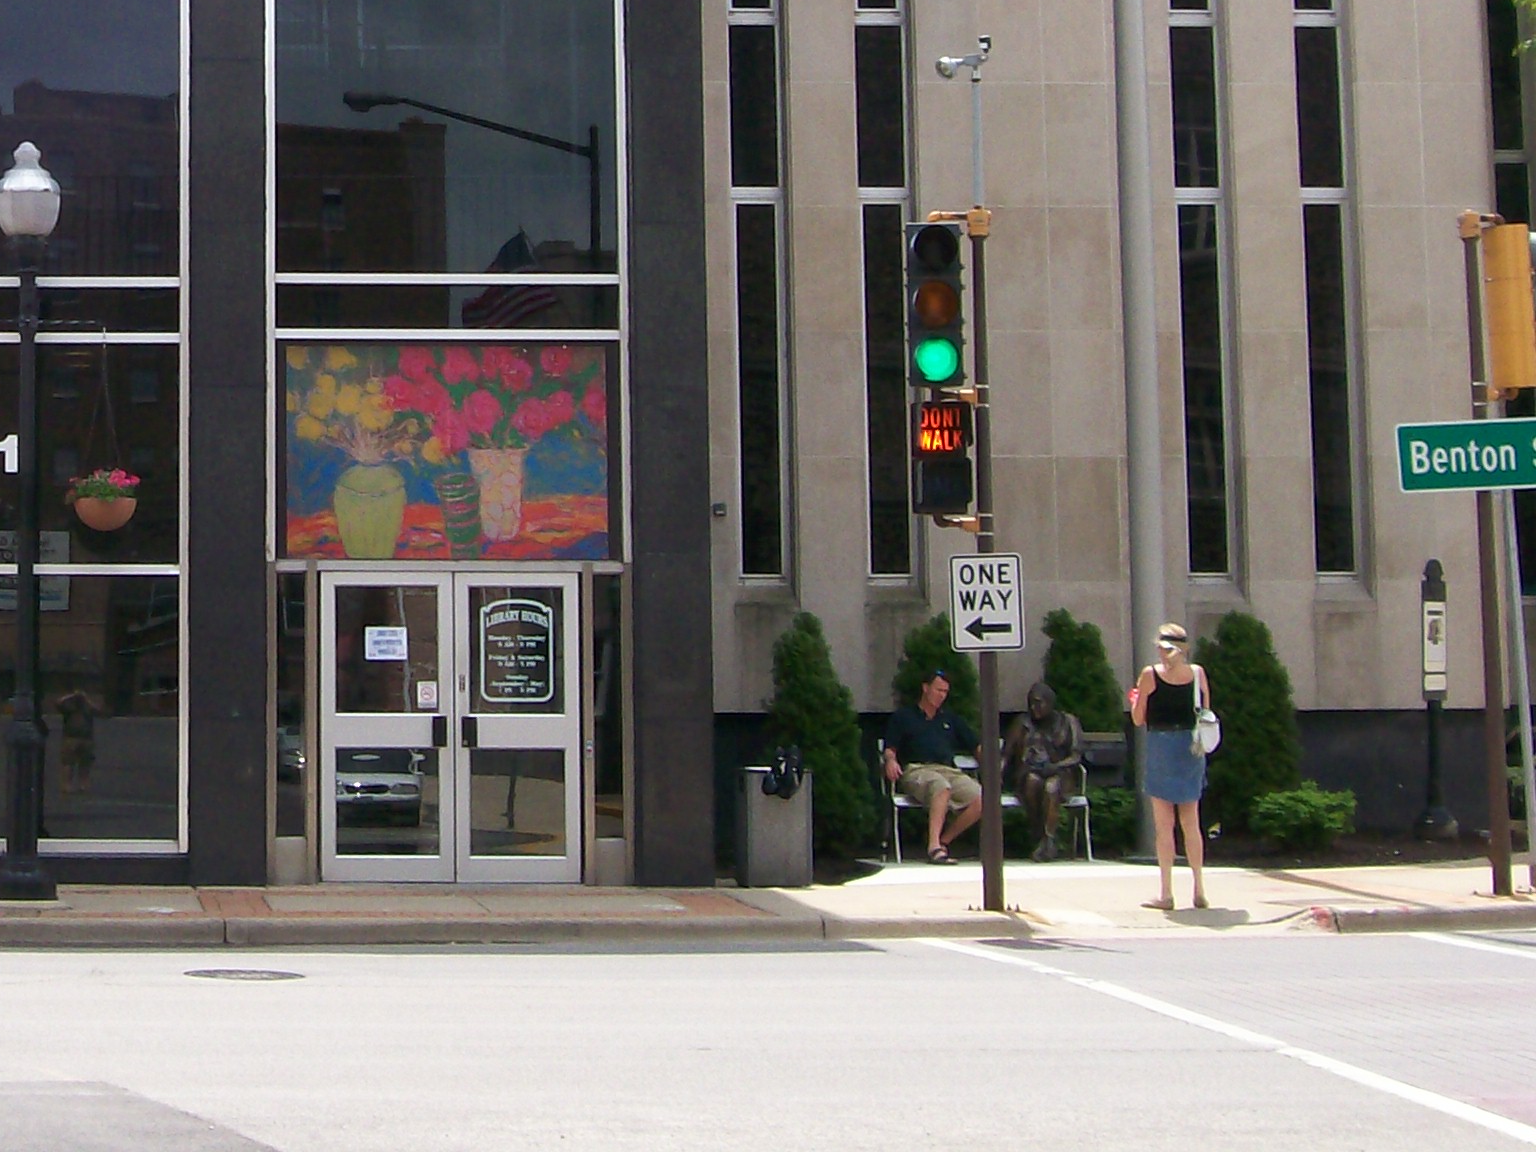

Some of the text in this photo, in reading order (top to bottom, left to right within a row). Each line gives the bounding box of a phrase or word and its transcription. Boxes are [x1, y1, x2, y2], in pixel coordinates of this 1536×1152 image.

[919, 428, 963, 451] WALK
[1409, 439, 1517, 474] Benton
[959, 563, 1011, 585] ONE
[958, 589, 1013, 611] WAY
[486, 609, 549, 628] LIBRARY HOURS
